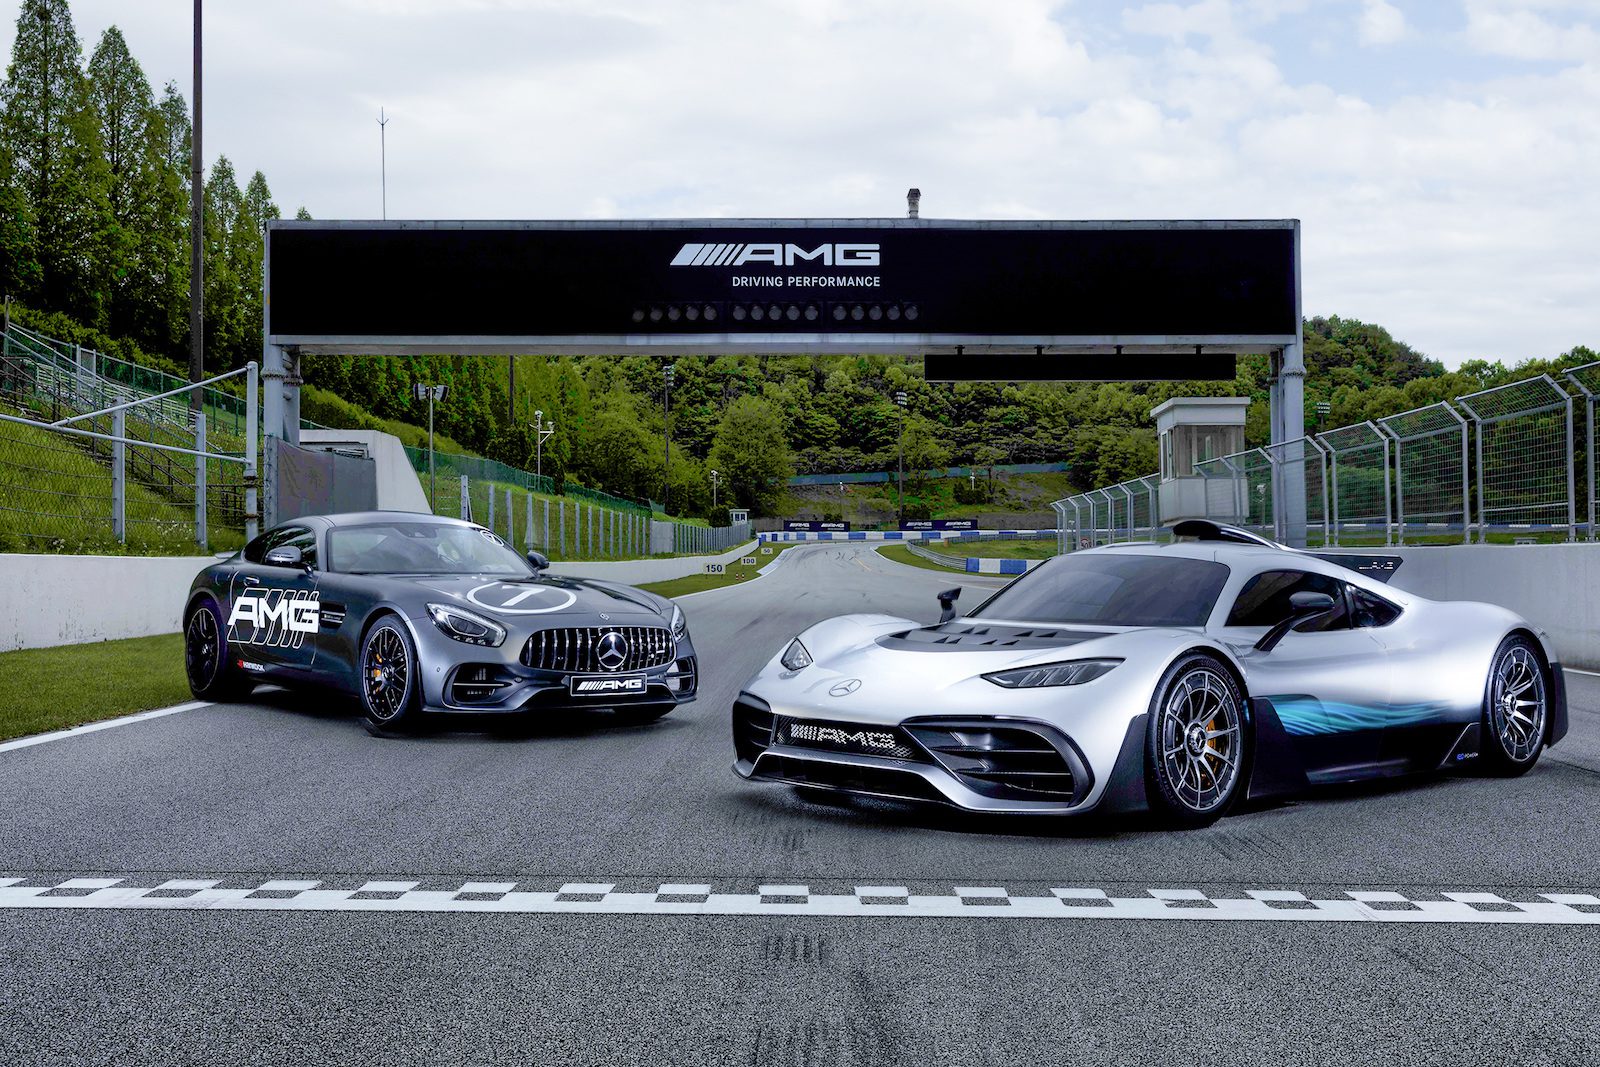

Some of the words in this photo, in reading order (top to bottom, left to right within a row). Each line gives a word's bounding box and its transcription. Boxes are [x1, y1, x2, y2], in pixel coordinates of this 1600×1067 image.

[732, 243, 880, 266] AMG
[732, 276, 783, 287] DRIVING
[787, 276, 881, 287] PERFORMANCE
[706, 564, 723, 573] 150
[501, 585, 546, 607] 7
[227, 596, 320, 634] AMG
[600, 679, 643, 690] AMG
[817, 727, 896, 749] AMG
